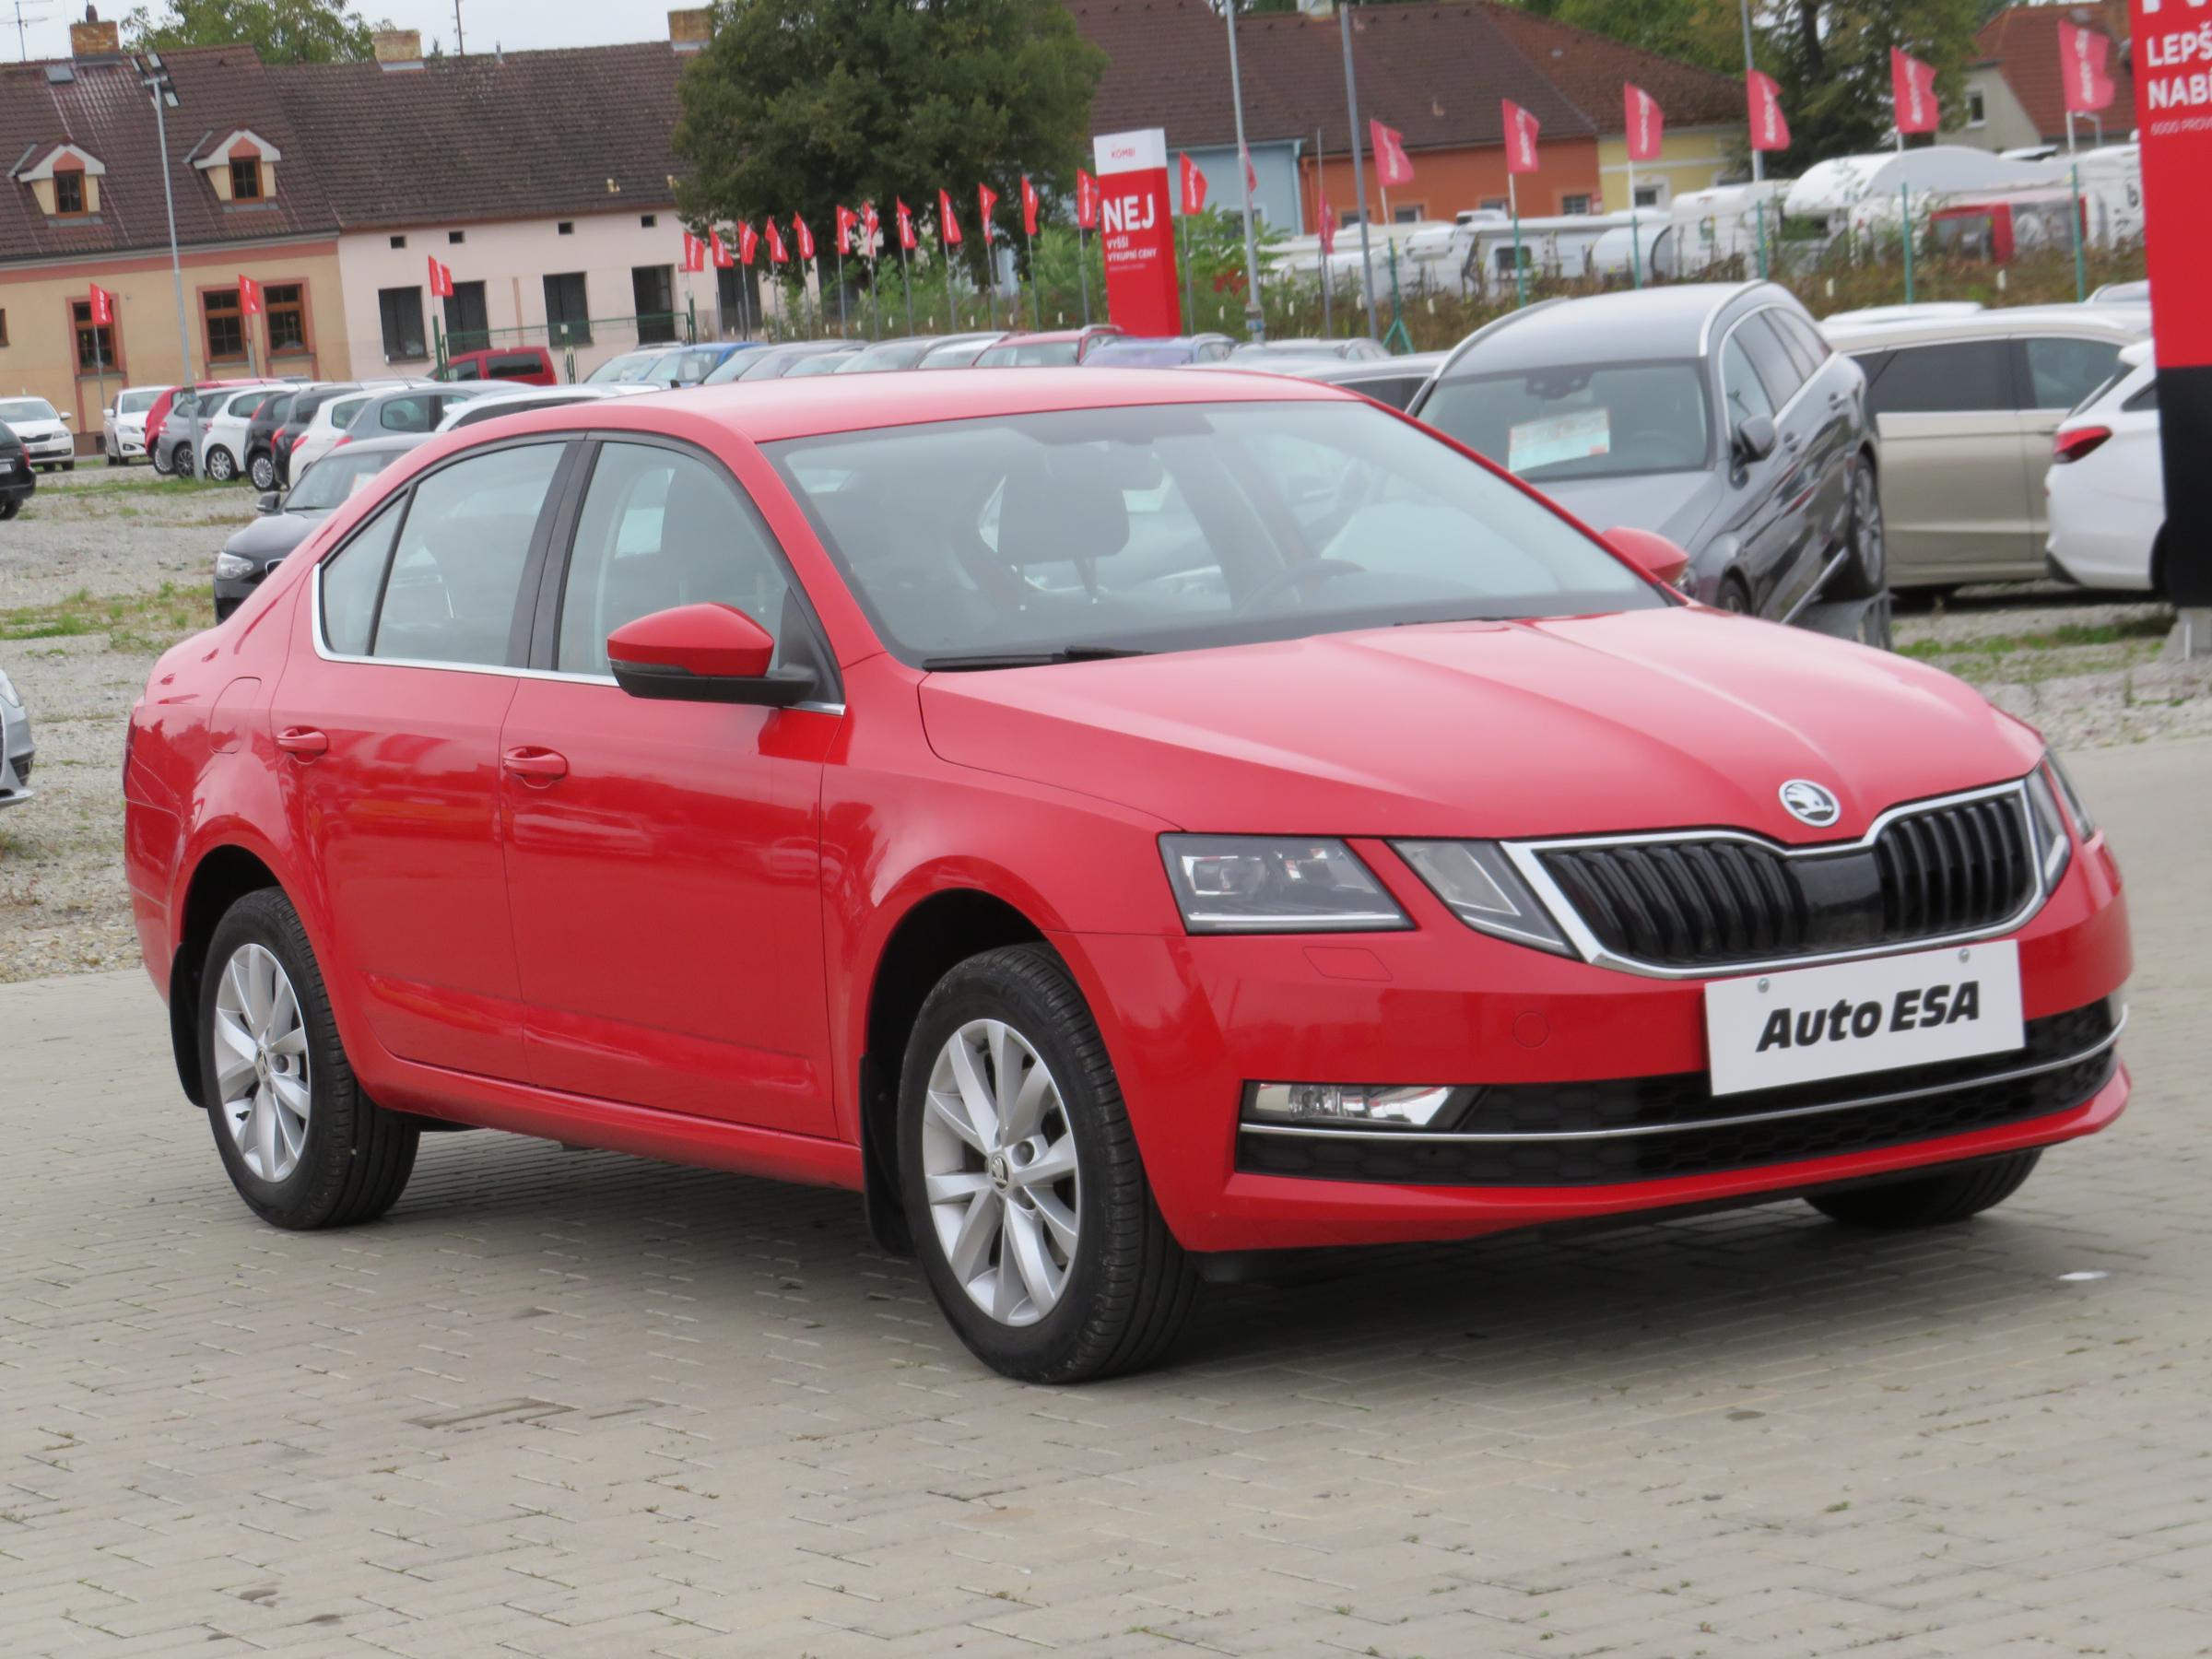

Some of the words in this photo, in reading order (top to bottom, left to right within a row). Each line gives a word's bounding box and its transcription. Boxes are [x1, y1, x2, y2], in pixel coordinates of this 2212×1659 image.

[2147, 67, 2212, 111] NAB
[1102, 193, 1155, 234] NEJ
[1756, 998, 1882, 1053] Auto
[1888, 981, 1979, 1032] ESA
